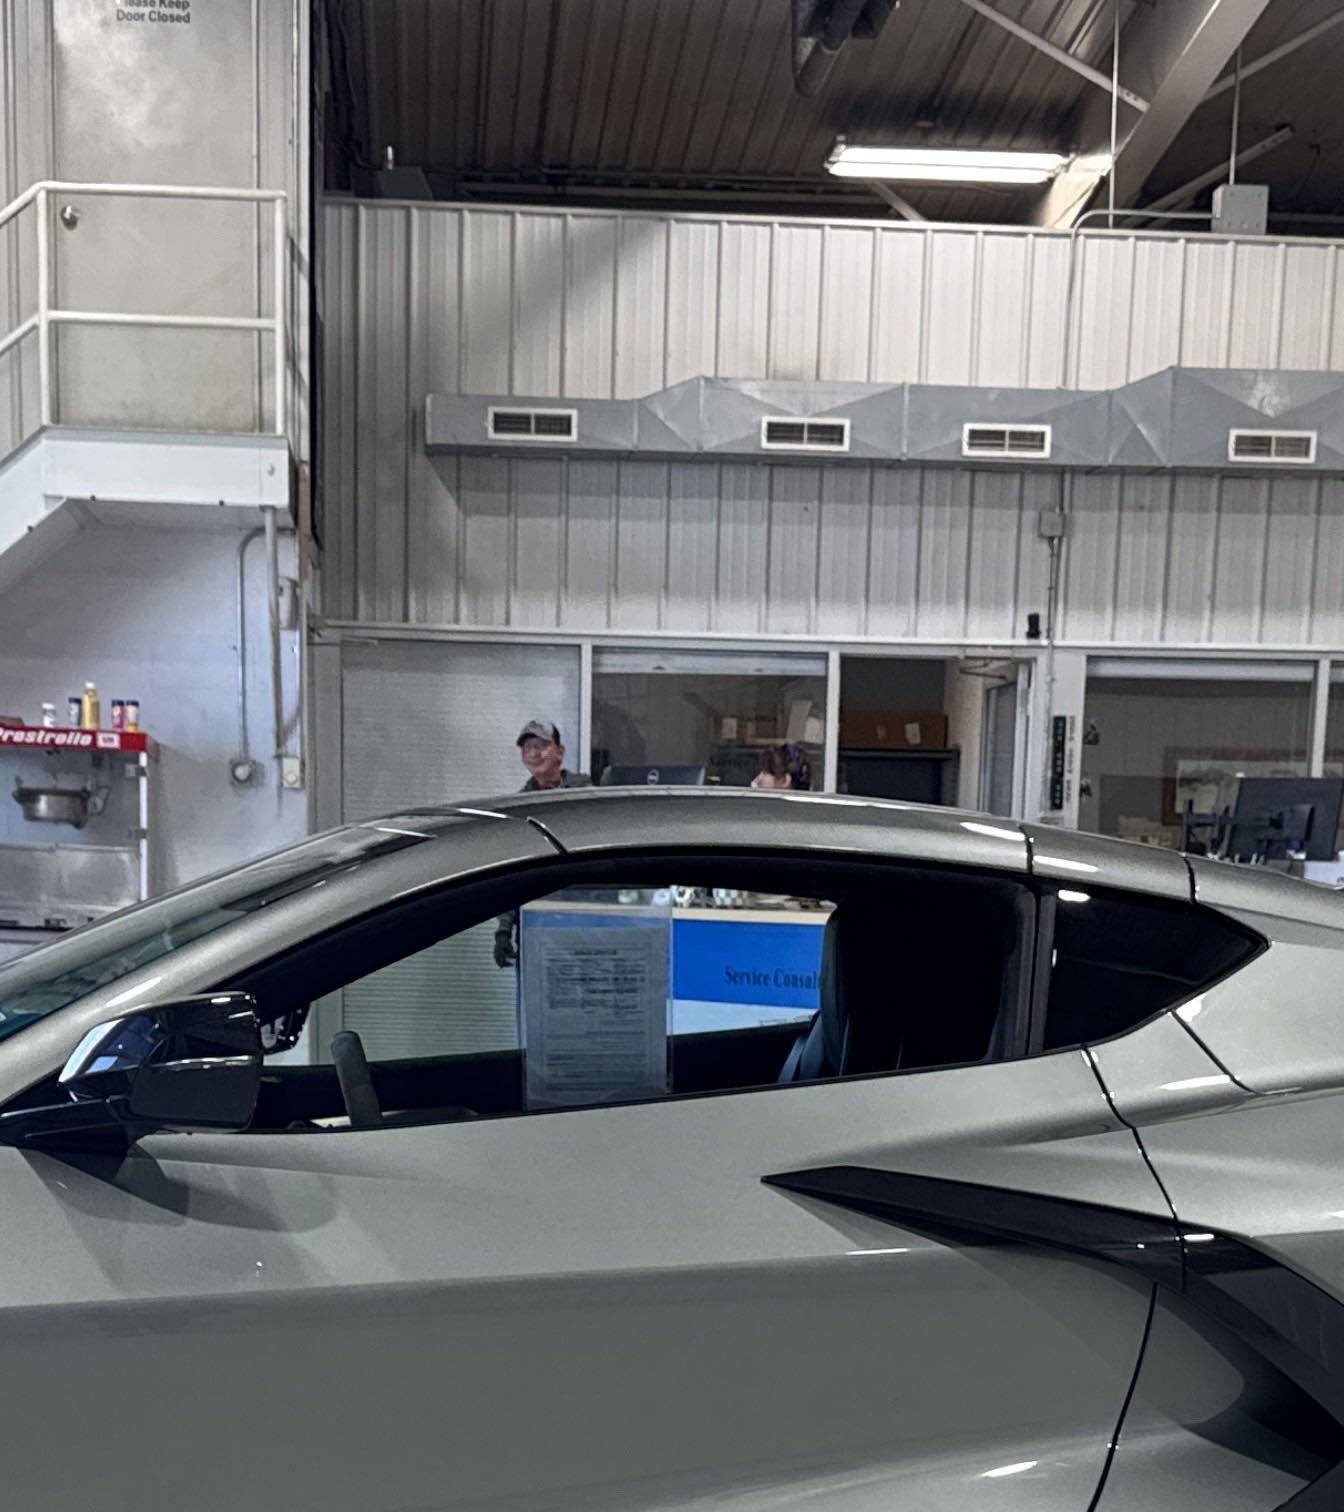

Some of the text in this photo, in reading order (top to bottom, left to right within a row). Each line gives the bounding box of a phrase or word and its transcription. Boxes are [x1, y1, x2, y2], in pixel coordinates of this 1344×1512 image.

[159, 0, 190, 11] Keep
[116, 9, 191, 23] Door Closed
[724, 965, 818, 990] Service Consul
